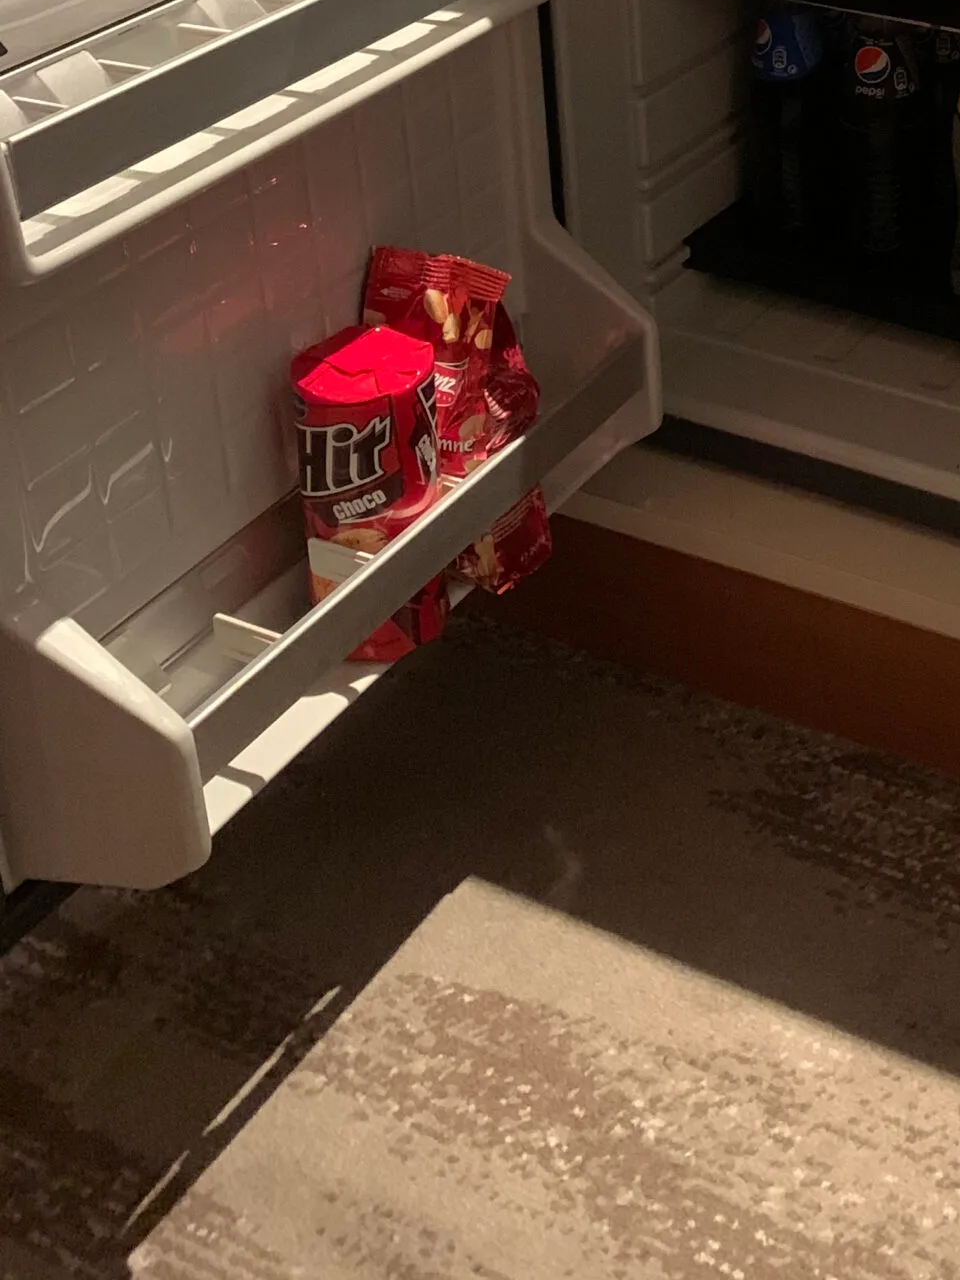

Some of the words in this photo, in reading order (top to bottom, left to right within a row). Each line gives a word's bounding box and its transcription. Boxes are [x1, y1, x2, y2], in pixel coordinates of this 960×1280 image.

[854, 85, 886, 100] pepsi
[296, 415, 392, 498] Hit
[332, 488, 388, 520] choco
